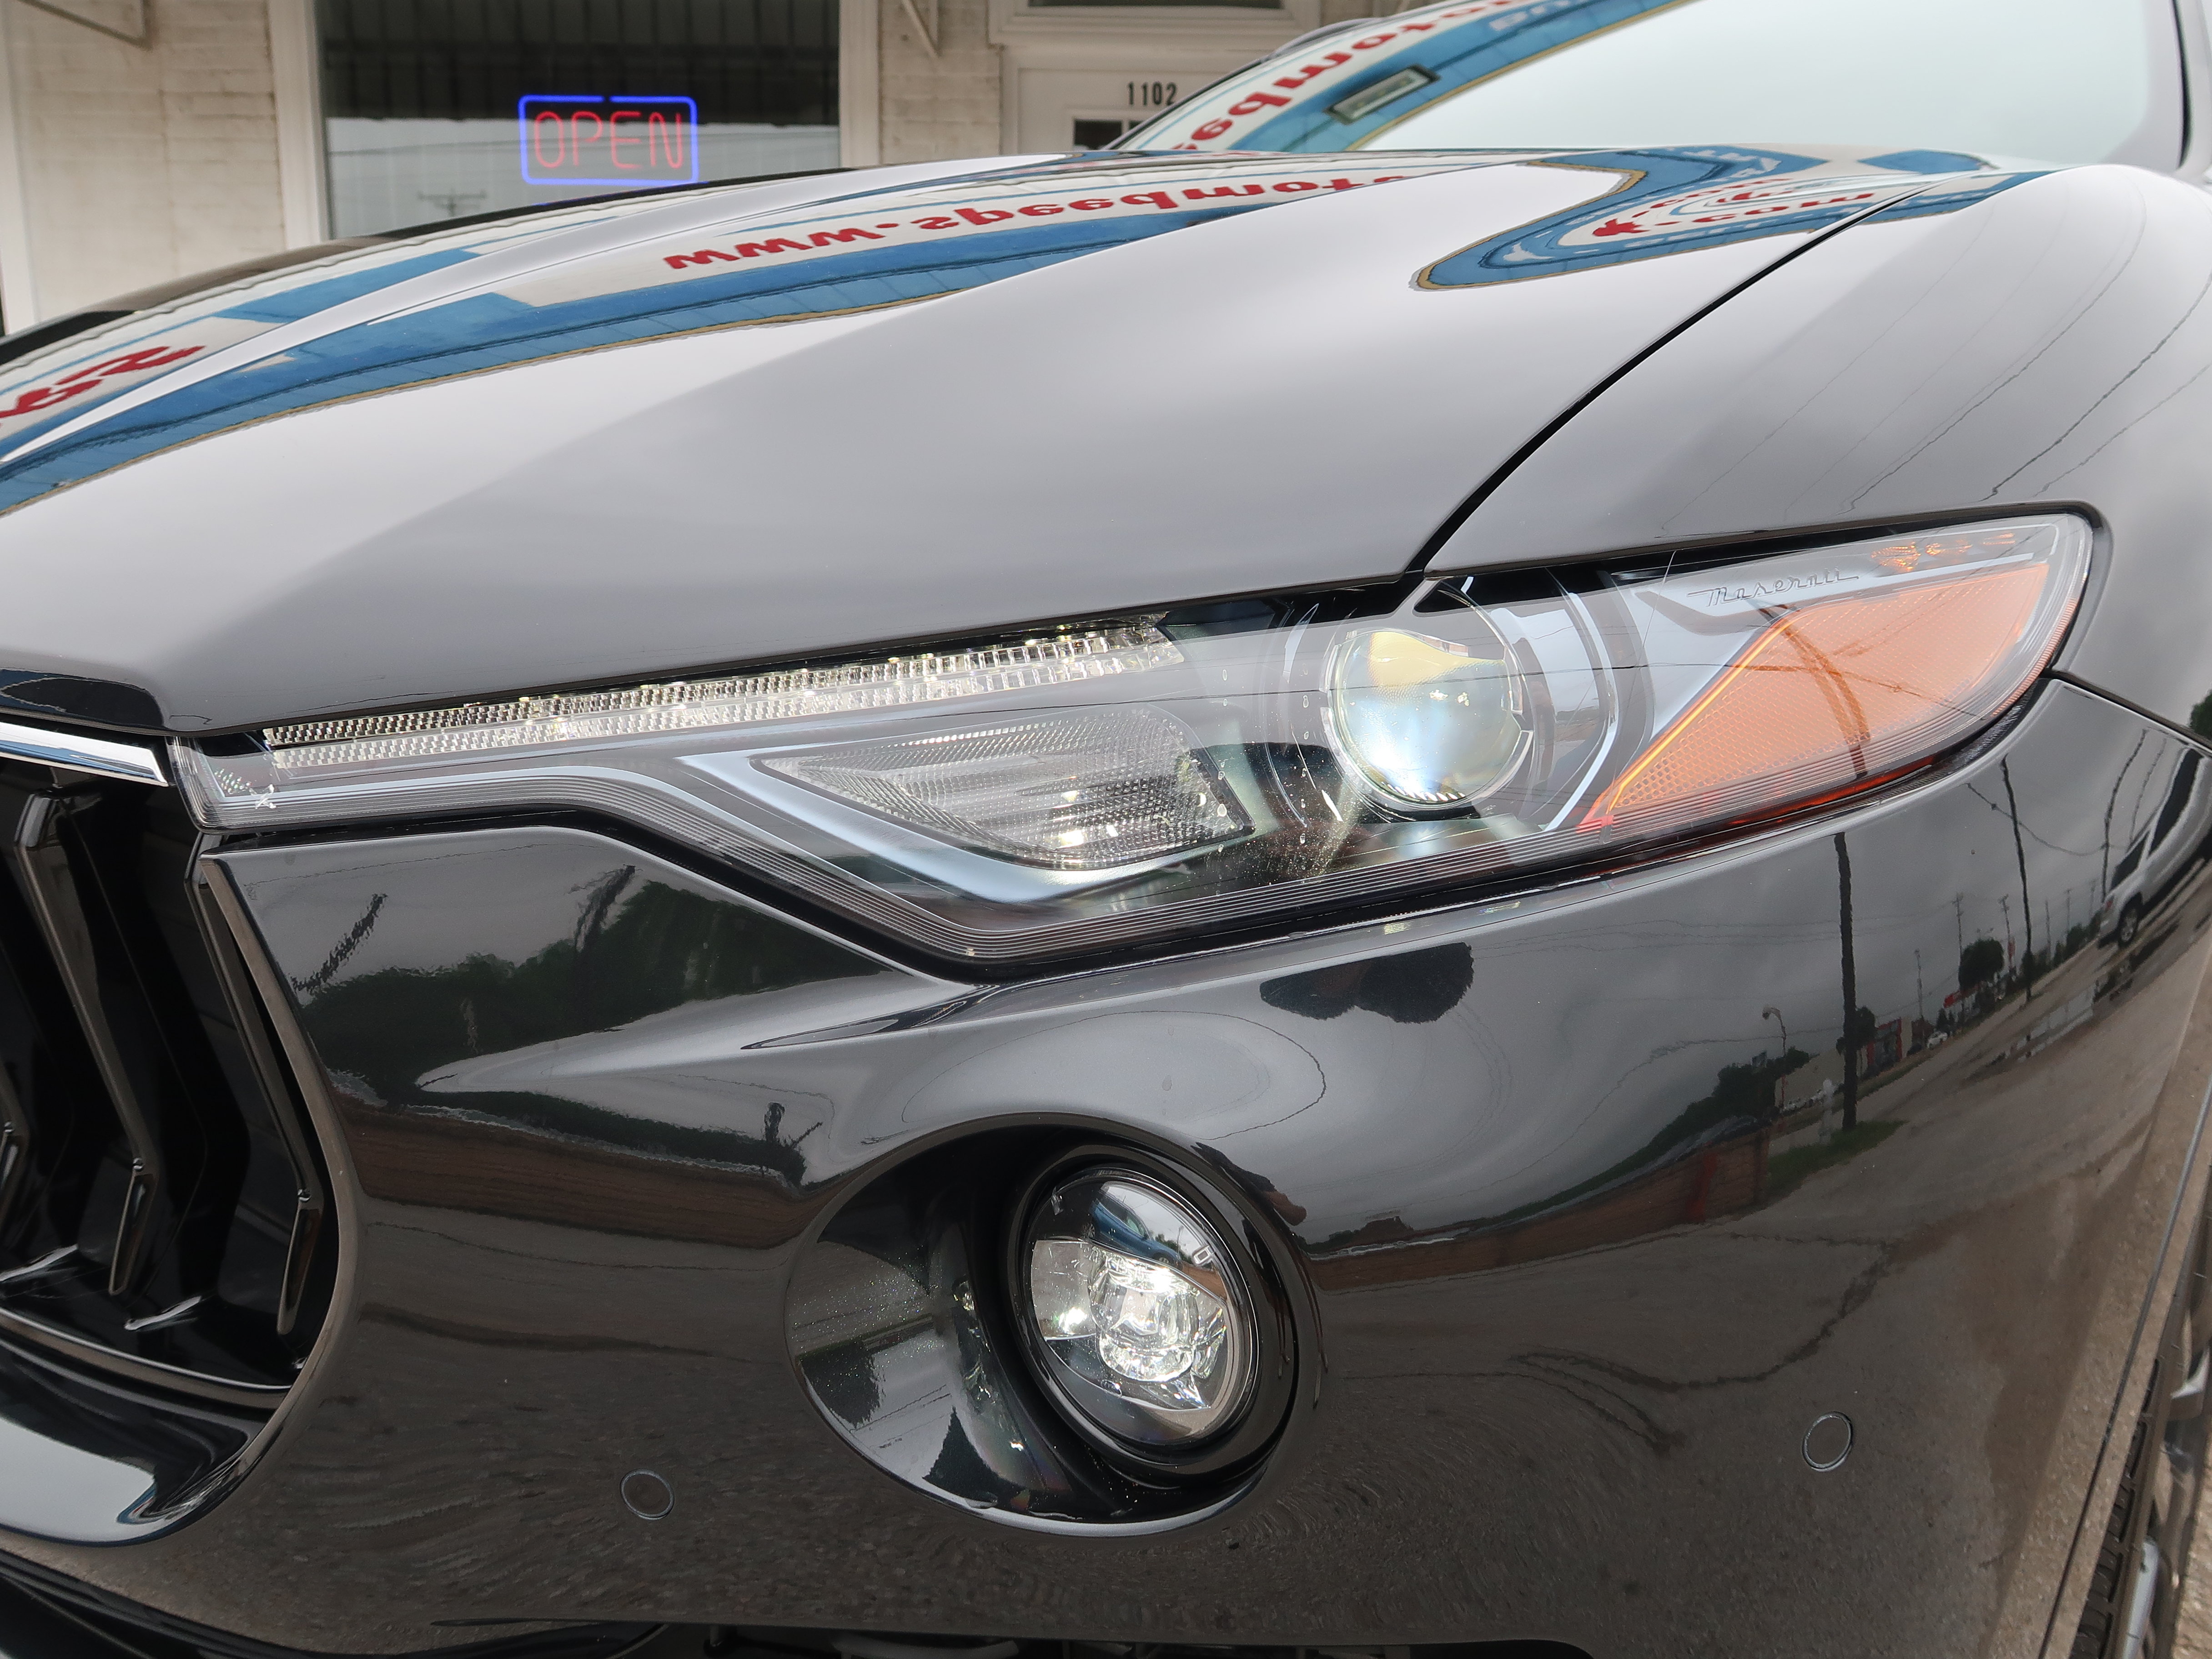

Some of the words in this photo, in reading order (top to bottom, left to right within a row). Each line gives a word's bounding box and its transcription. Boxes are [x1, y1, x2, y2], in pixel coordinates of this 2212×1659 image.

[1127, 81, 1177, 106] 1102
[533, 110, 684, 169] OPEN
[1686, 566, 1860, 608] Maserati
